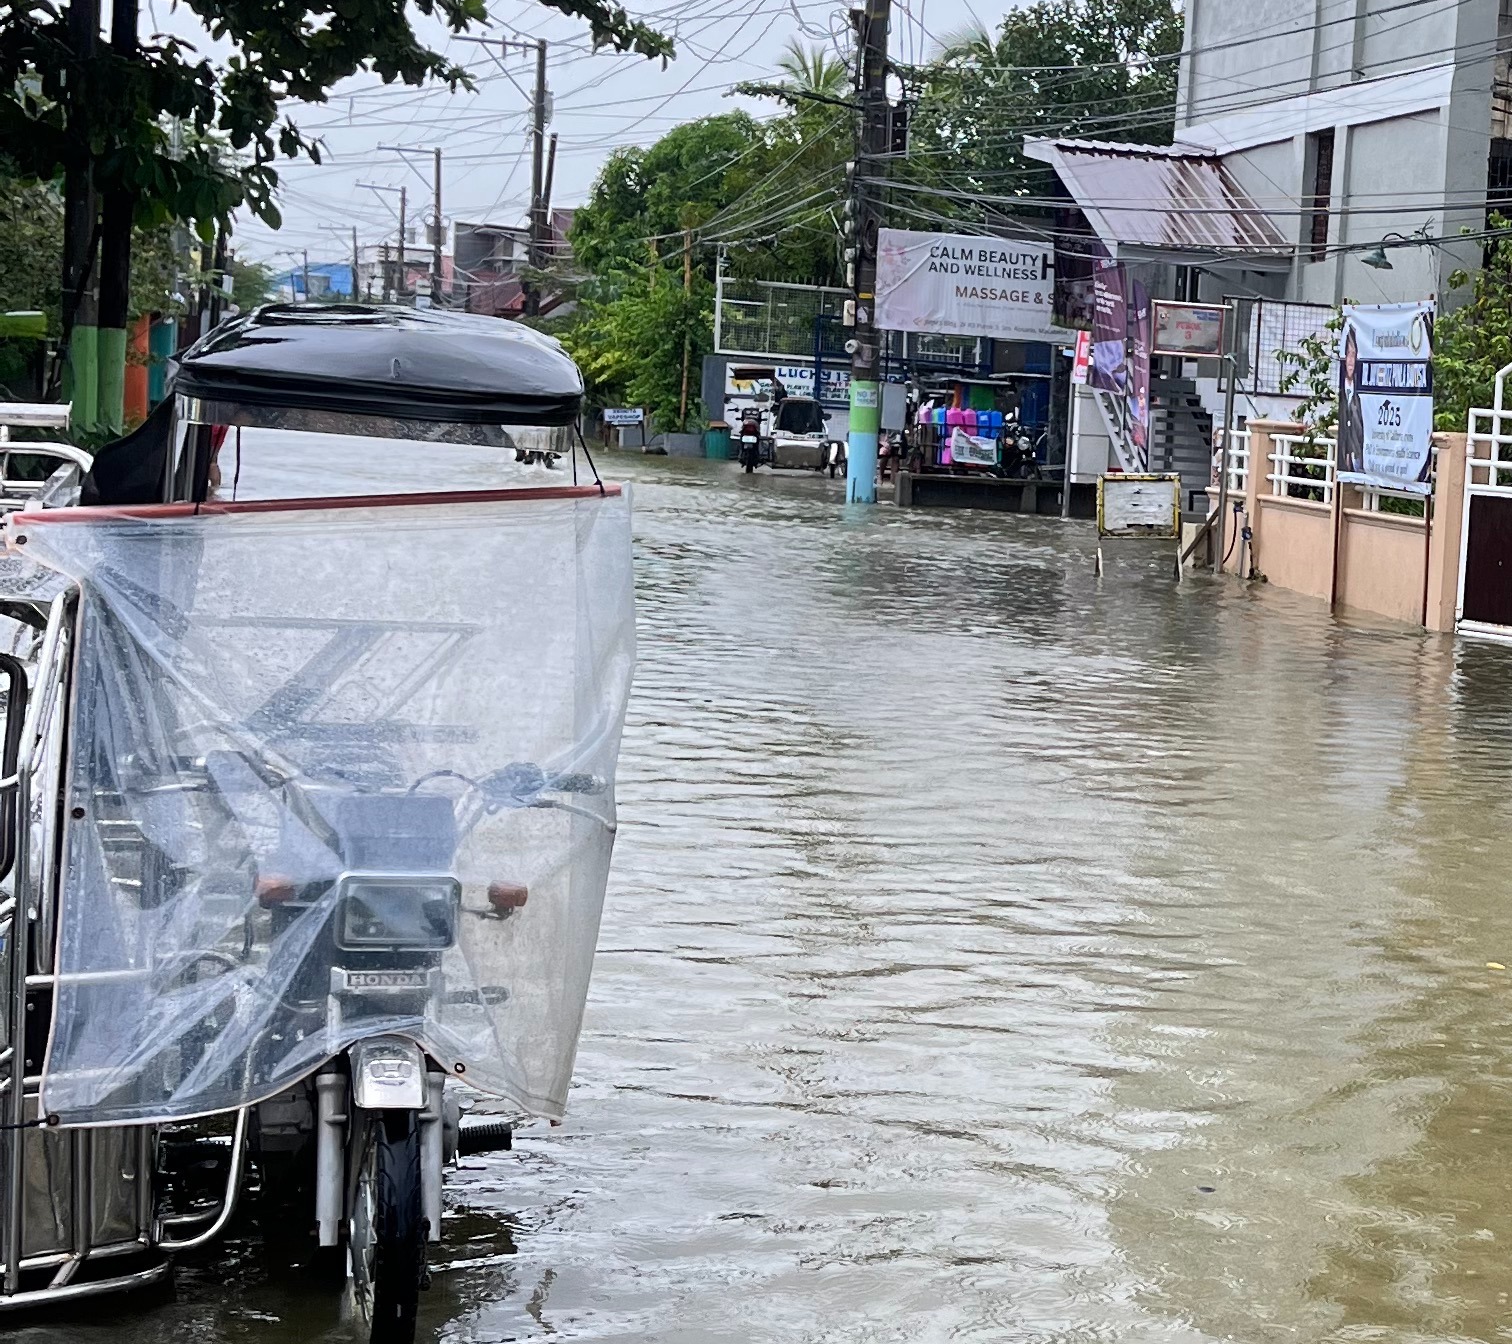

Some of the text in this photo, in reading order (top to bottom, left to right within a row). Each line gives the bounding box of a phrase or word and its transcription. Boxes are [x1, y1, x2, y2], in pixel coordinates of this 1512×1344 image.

[930, 246, 1039, 267] CALM BEAUTY
[928, 261, 1038, 281] AND WELLNESS
[955, 285, 1030, 304] MASSAGE
[1033, 291, 1044, 305] &
[1378, 406, 1401, 426] 2025
[350, 974, 424, 987] HONDA
